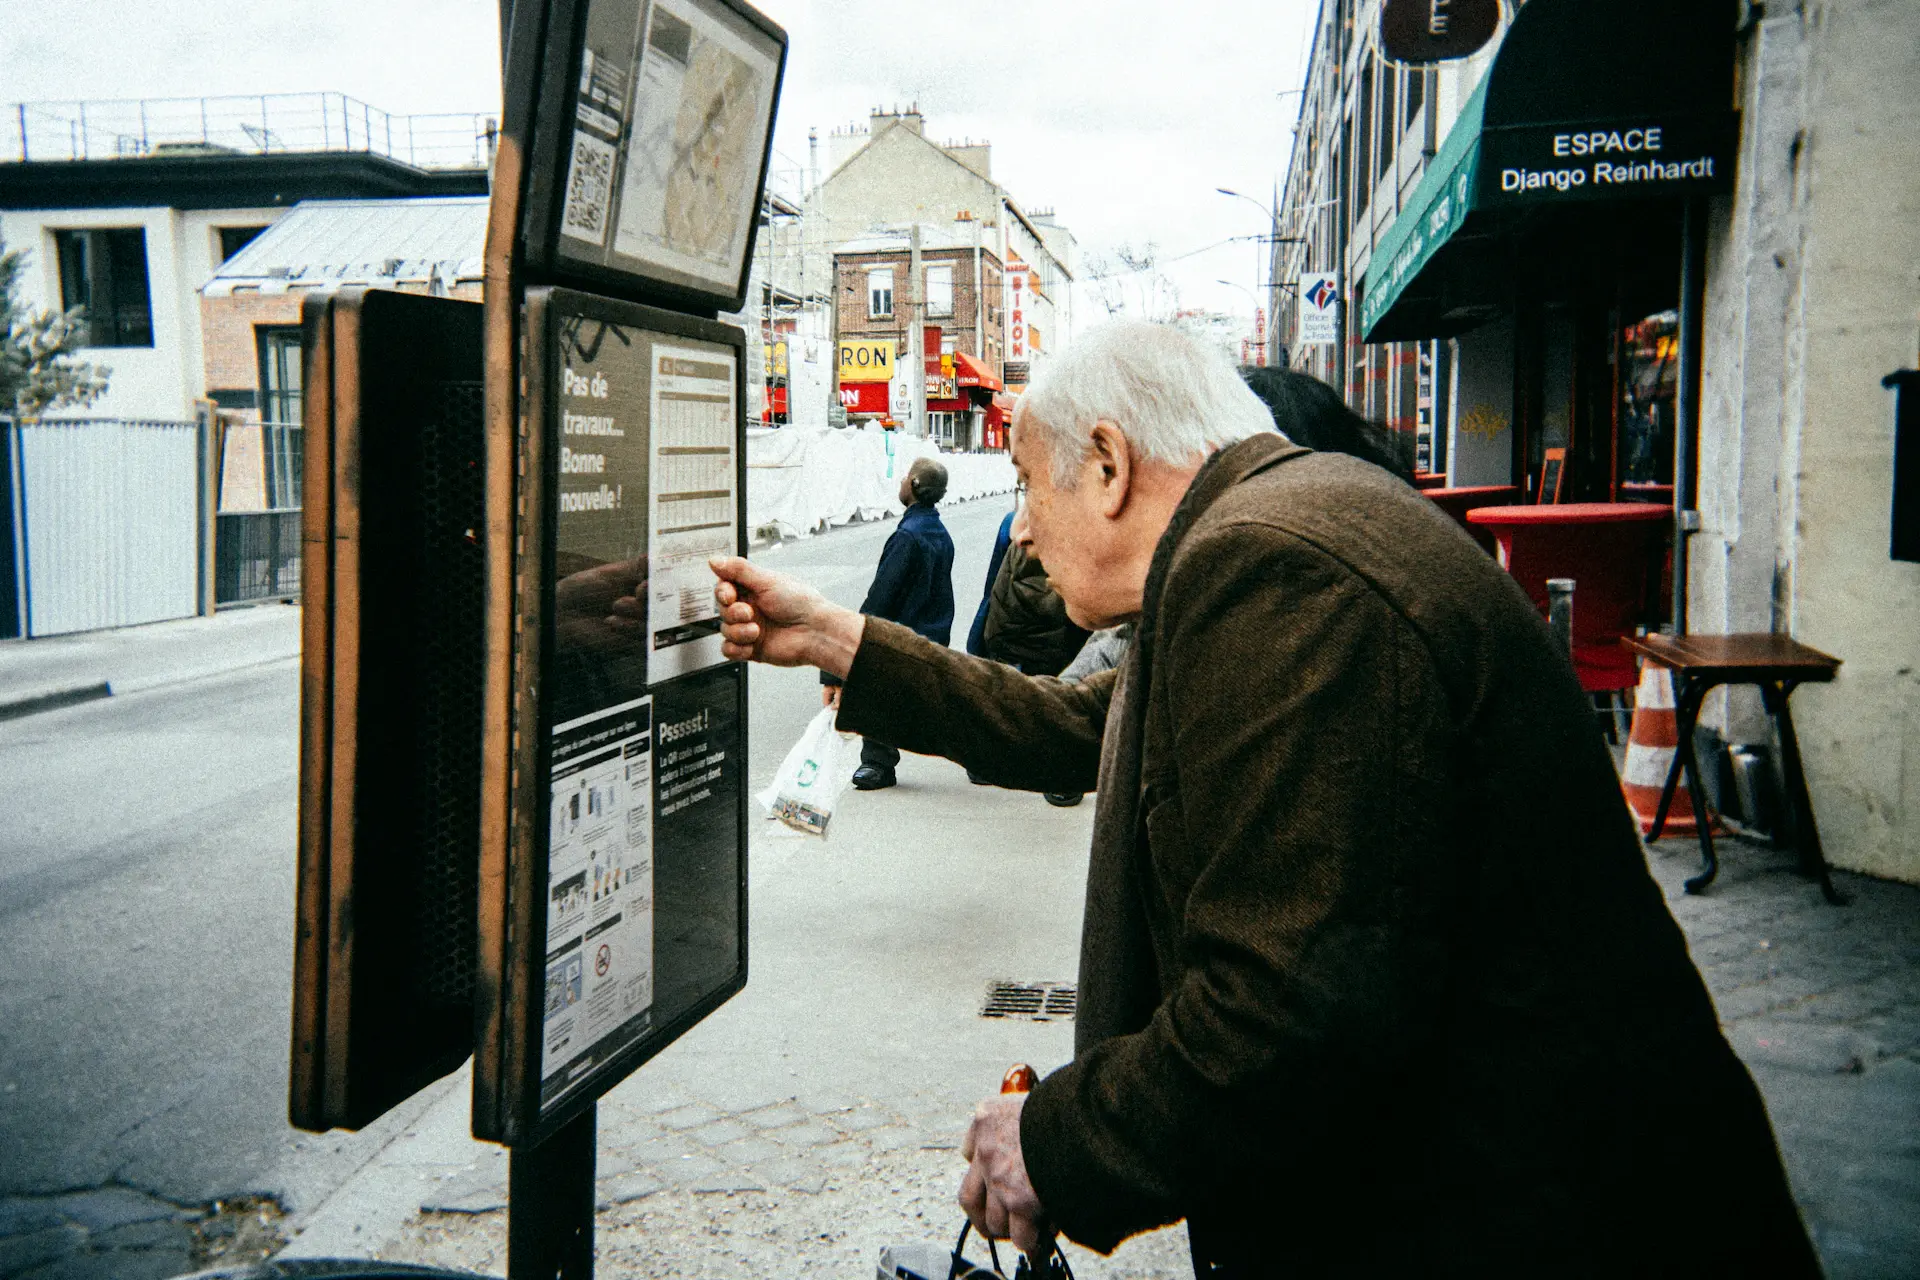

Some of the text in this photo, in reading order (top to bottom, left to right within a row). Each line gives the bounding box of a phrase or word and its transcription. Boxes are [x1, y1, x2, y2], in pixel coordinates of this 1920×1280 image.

[1553, 128, 1662, 157] ESPACE
[1501, 156, 1715, 194] Django Reinhardt
[1012, 275, 1023, 357] BIRON
[563, 368, 609, 399] Pas de
[561, 447, 606, 474] Bonne
